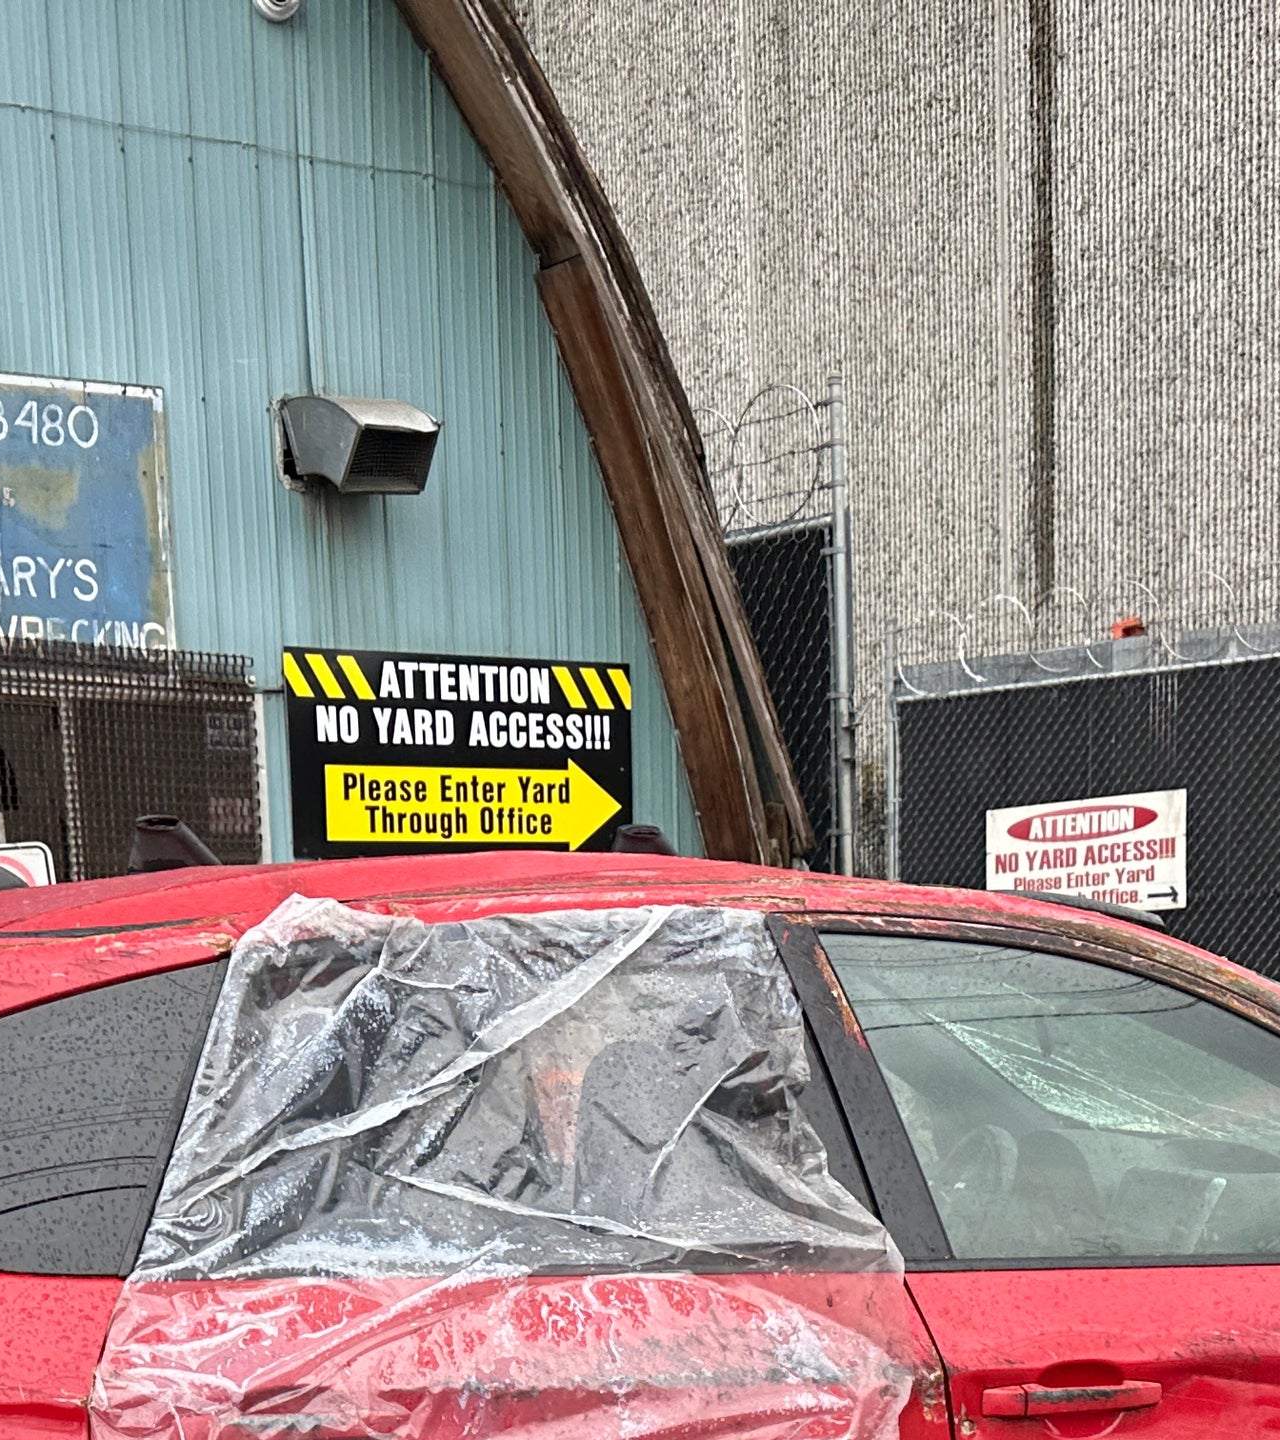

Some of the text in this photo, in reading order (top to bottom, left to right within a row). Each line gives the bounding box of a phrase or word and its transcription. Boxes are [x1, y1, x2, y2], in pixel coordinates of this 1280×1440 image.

[380, 661, 550, 704] ATTENTION
[316, 705, 610, 749] NO YARD ACCESS!!!
[343, 773, 569, 803] Please Enter Yard
[365, 806, 552, 838] Through Office
[1029, 807, 1134, 839] ATTENTION
[995, 838, 1175, 874] NO YARD ACCESS!!!
[1014, 865, 1154, 890] Please Enter Yard
